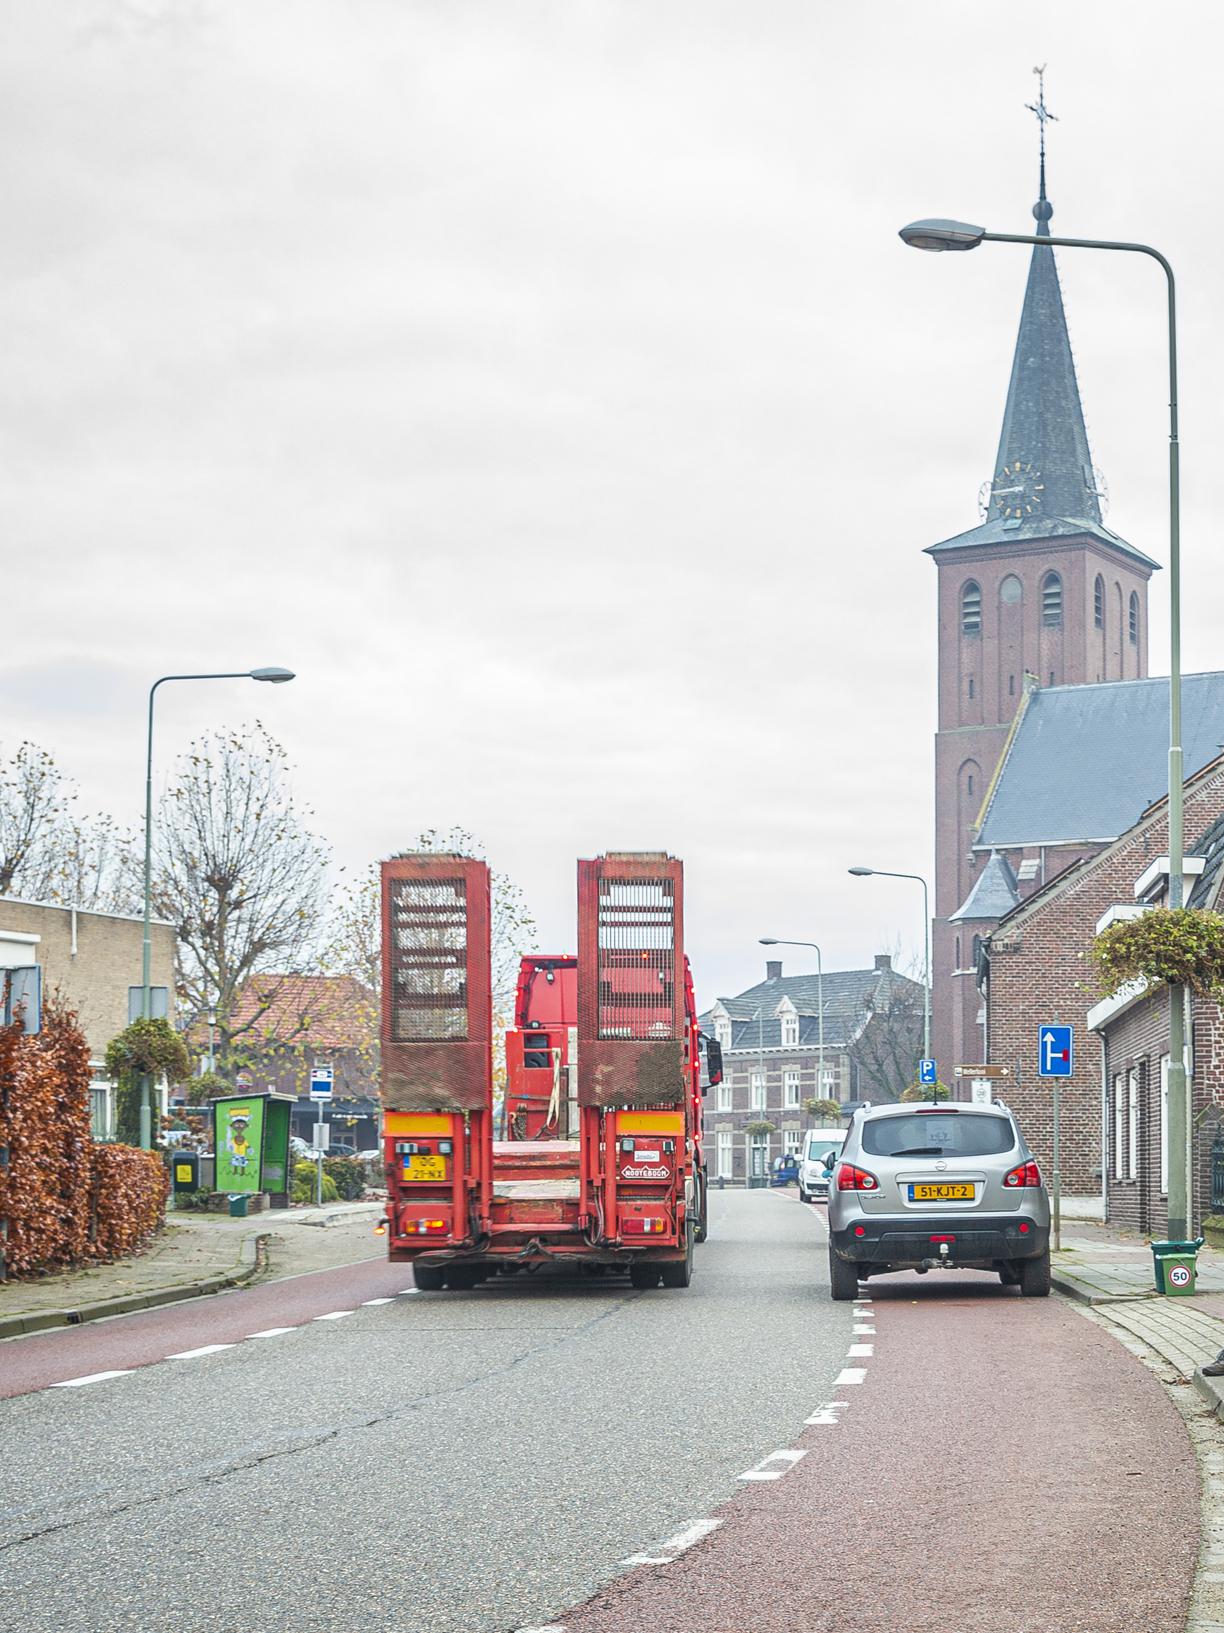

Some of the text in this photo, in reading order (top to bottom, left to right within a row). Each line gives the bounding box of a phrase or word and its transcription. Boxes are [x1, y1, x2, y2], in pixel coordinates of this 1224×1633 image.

[625, 1169, 667, 1178] NOOTEBOOM
[920, 1185, 968, 1198] 51-KJT-2
[1173, 1271, 1188, 1282] 50
